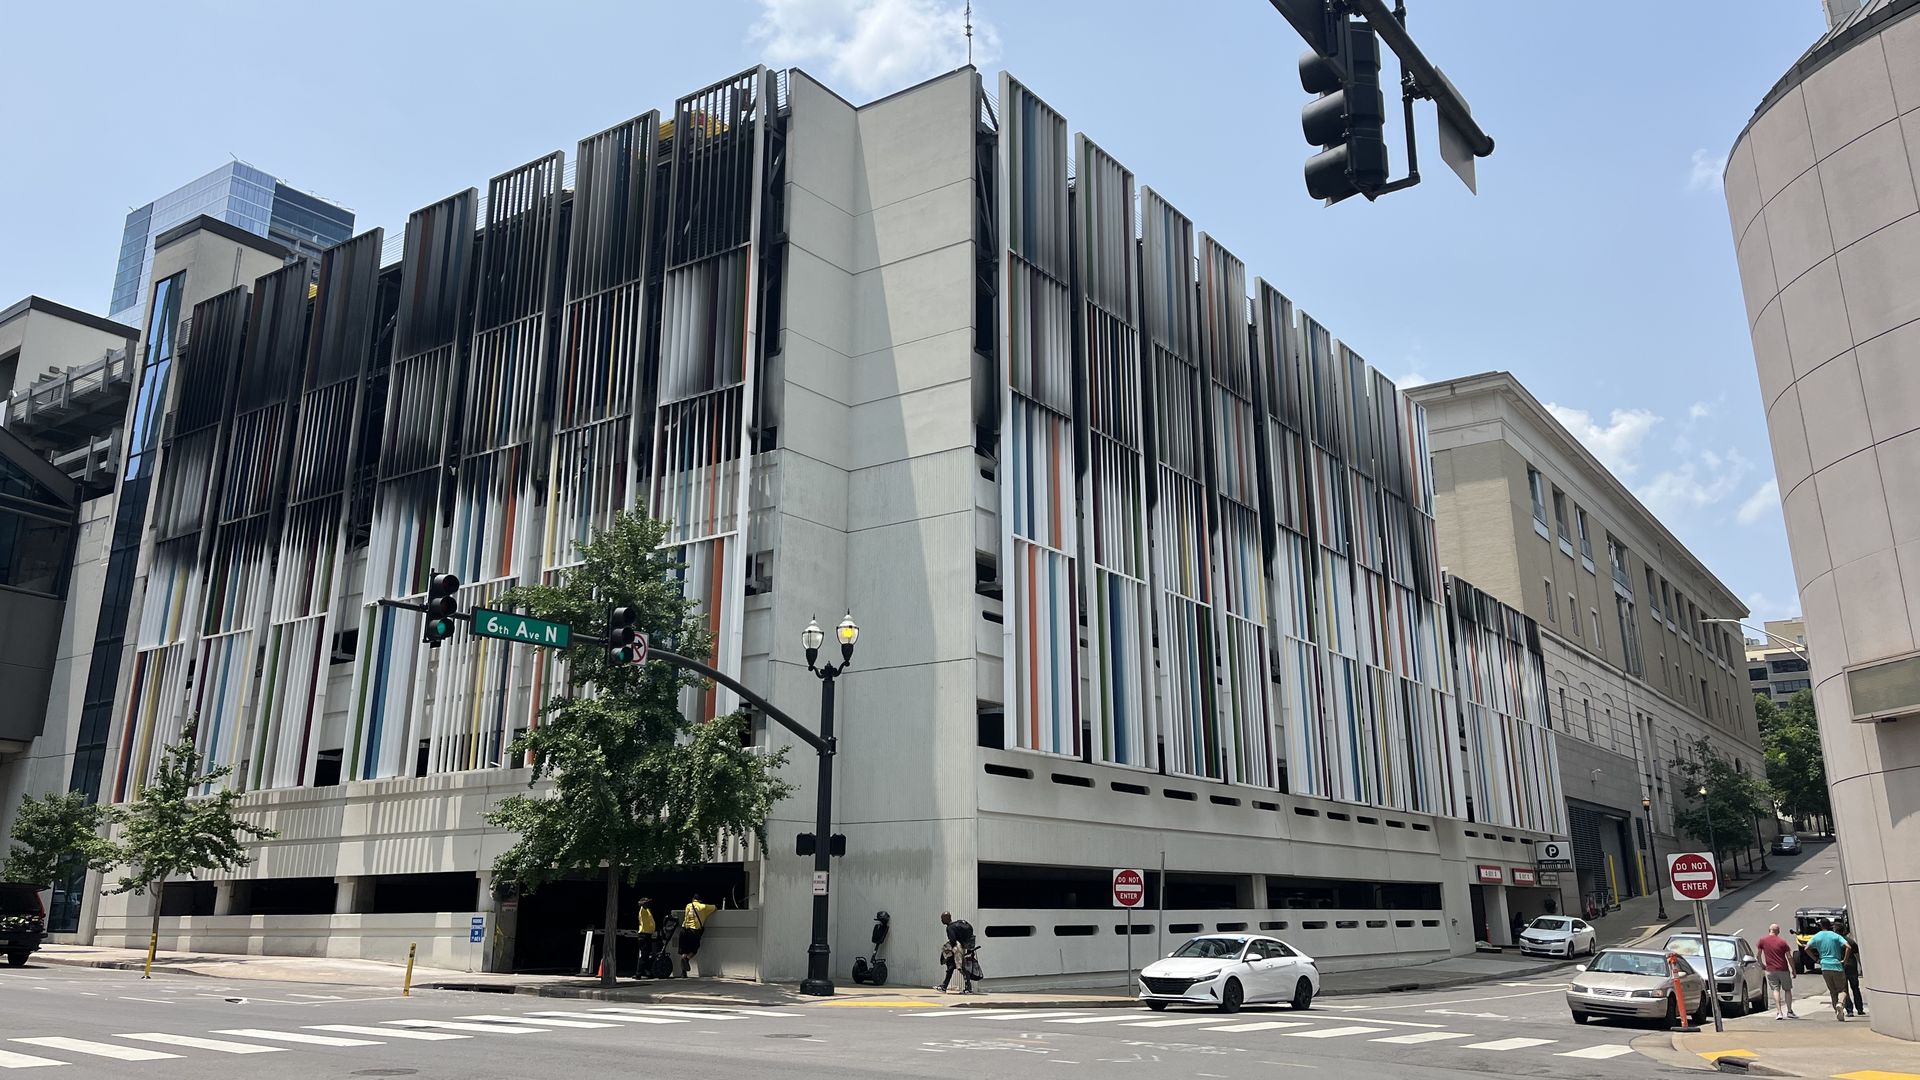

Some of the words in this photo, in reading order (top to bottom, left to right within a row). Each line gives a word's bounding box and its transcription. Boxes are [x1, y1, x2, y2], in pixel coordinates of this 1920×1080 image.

[487, 617, 509, 635] 6th
[515, 621, 540, 640] Ave
[545, 625, 558, 643] N
[1549, 846, 1557, 857] P
[1676, 863, 1687, 871] DO
[1691, 862, 1707, 870] NOT
[1682, 882, 1708, 891] ENTER
